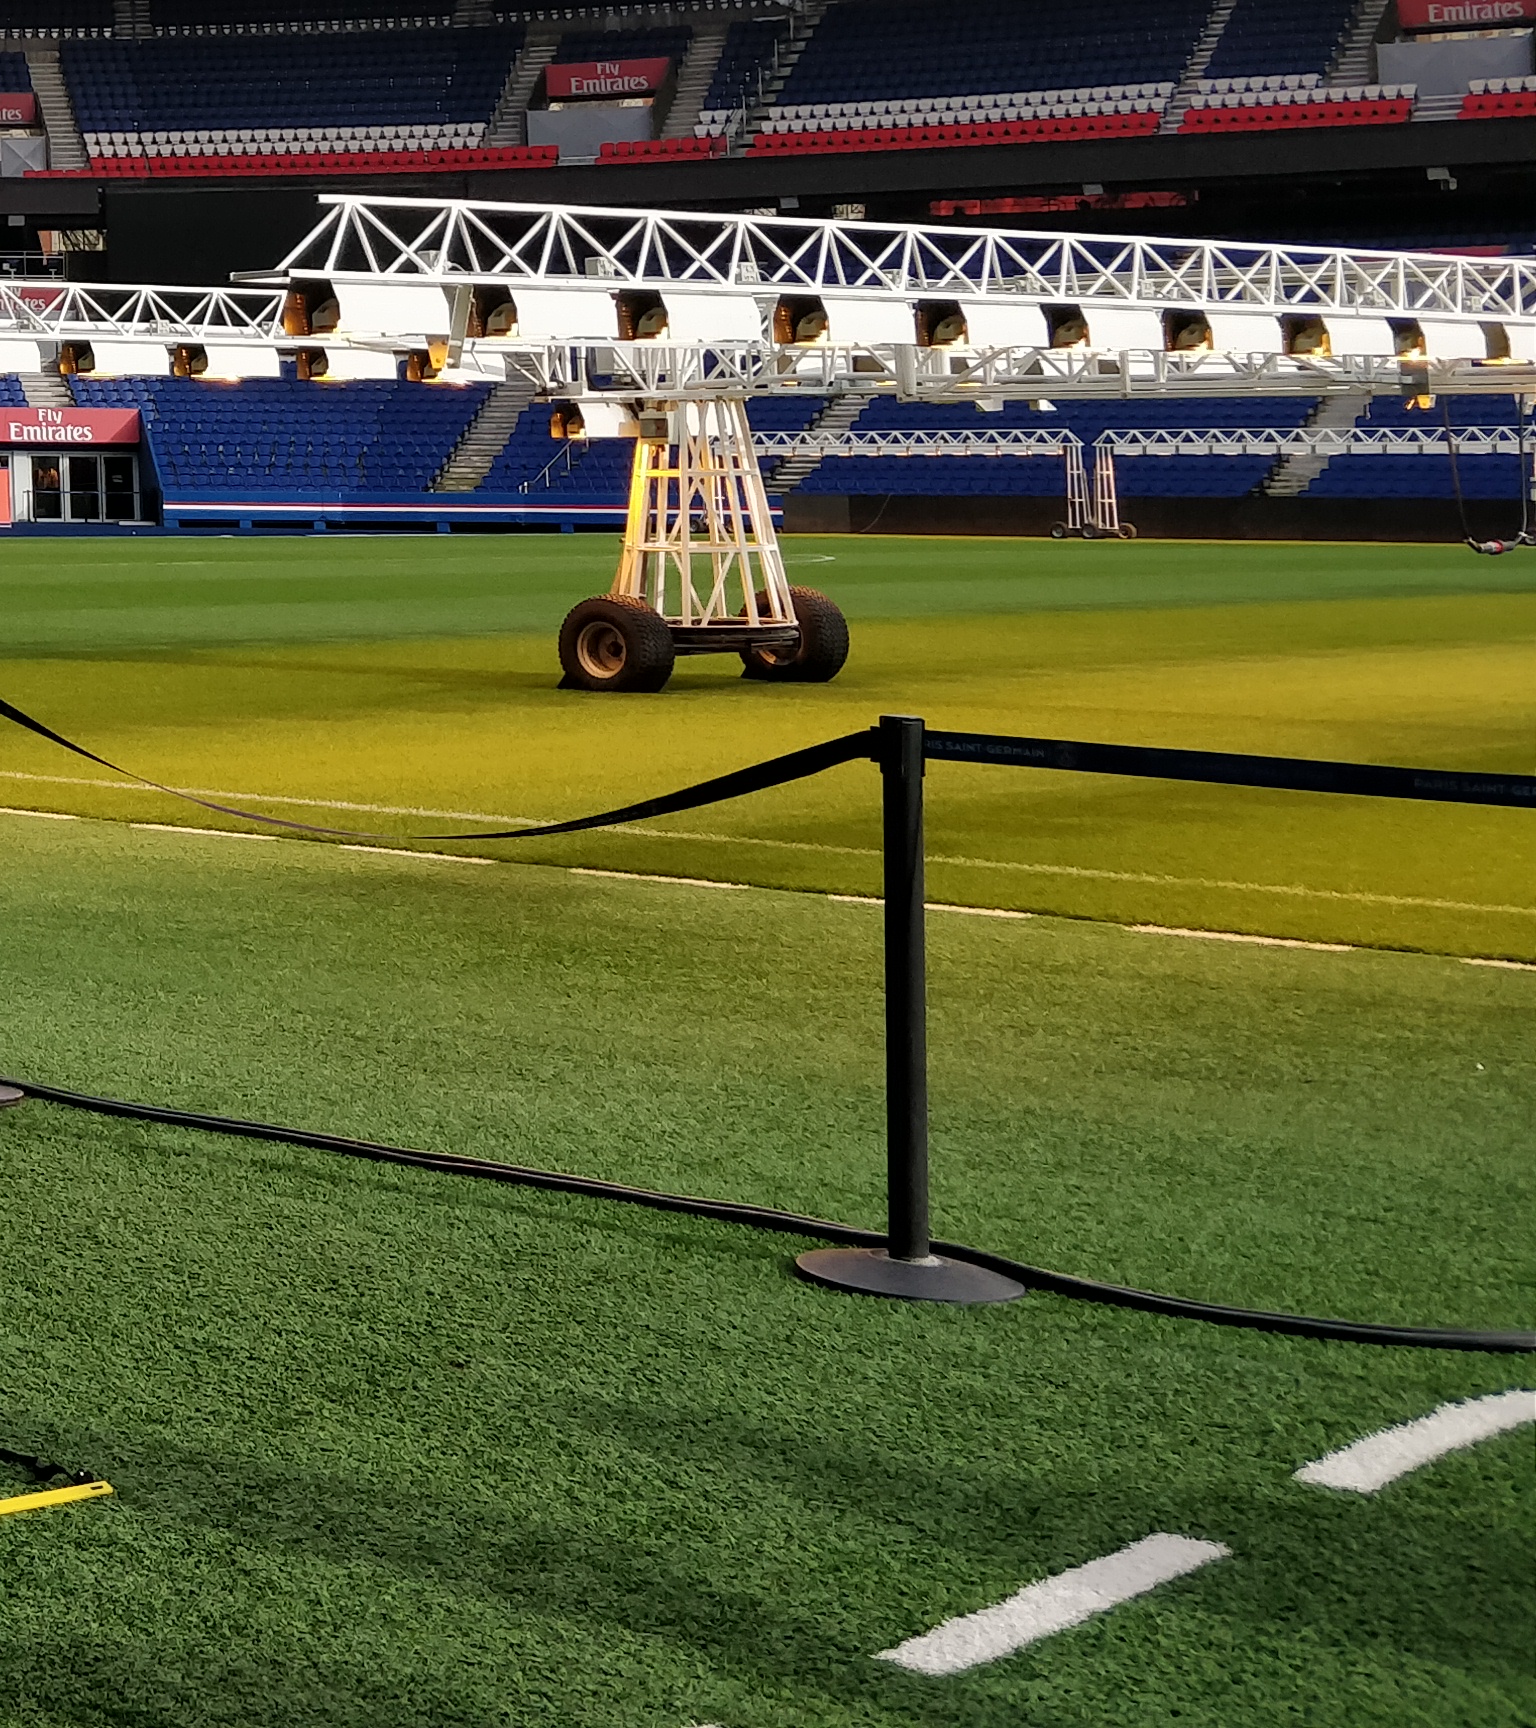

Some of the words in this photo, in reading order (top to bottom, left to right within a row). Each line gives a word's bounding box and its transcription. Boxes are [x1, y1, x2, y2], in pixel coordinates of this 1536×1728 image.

[1429, 1, 1524, 23] Emirates
[596, 62, 620, 76] Fly
[570, 75, 648, 95] Emirates
[38, 408, 62, 424] Fly
[9, 421, 92, 441] Emirates
